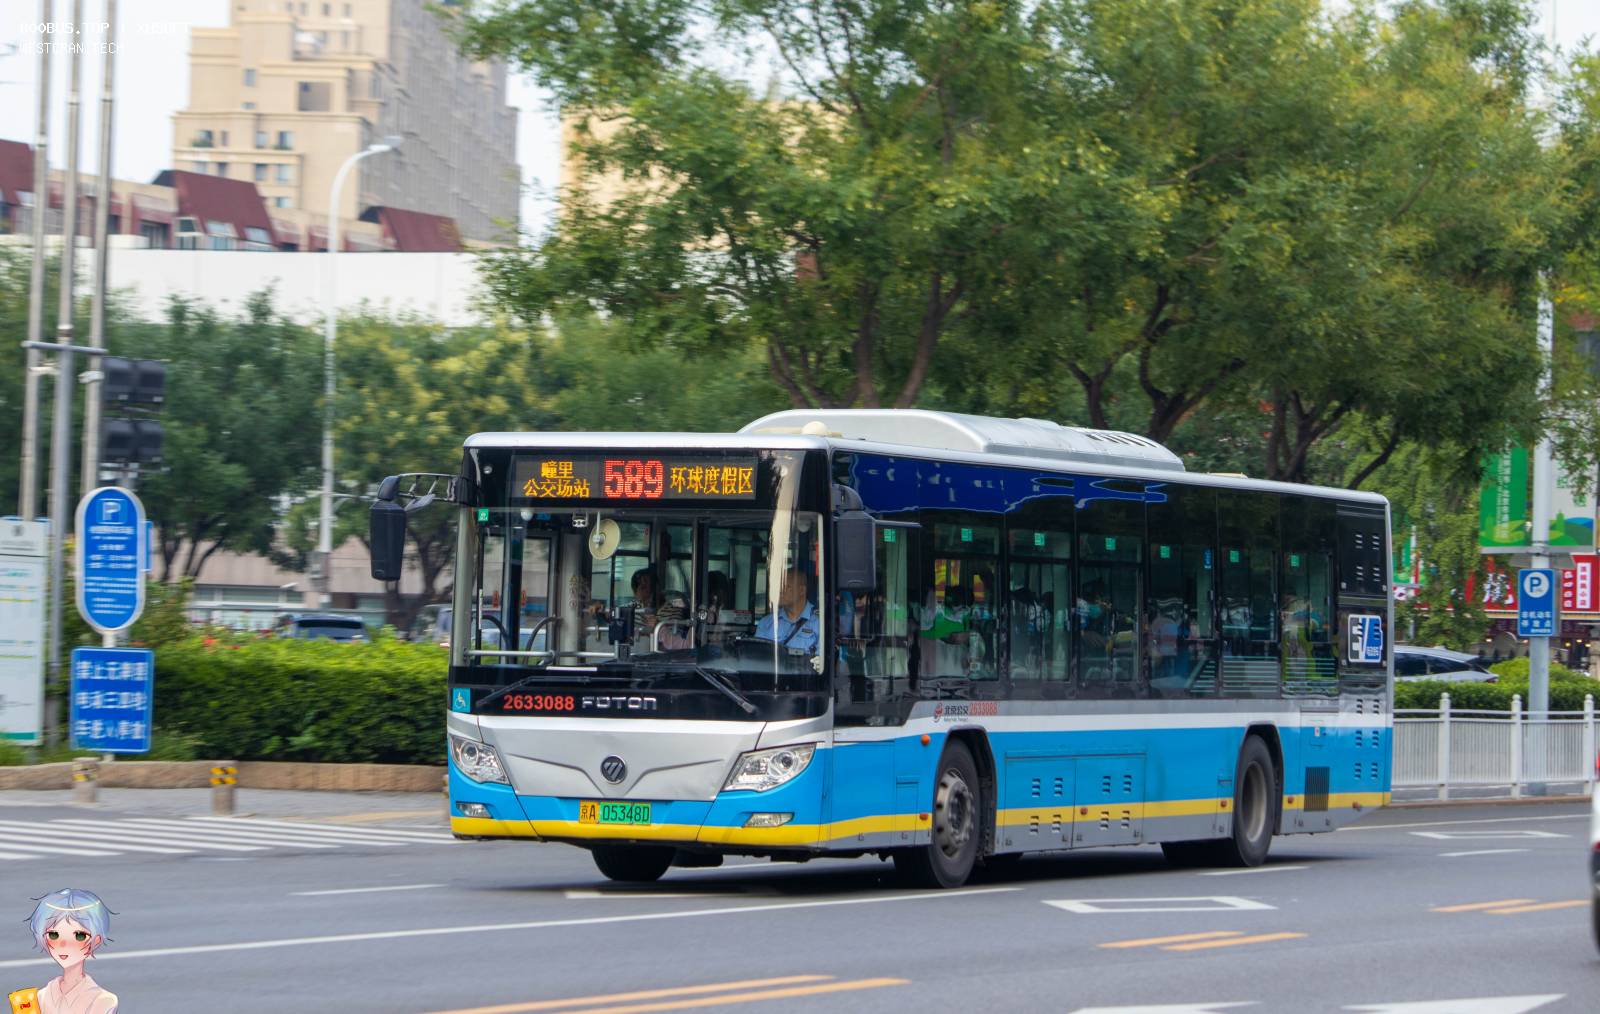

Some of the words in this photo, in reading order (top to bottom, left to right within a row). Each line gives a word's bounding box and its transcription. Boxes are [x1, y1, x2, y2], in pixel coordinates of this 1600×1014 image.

[523, 479, 590, 498] 公交场站
[604, 460, 663, 498] 589
[670, 466, 753, 495] 环球度假区
[503, 695, 574, 711] 2633088
[582, 696, 657, 710] FOTON
